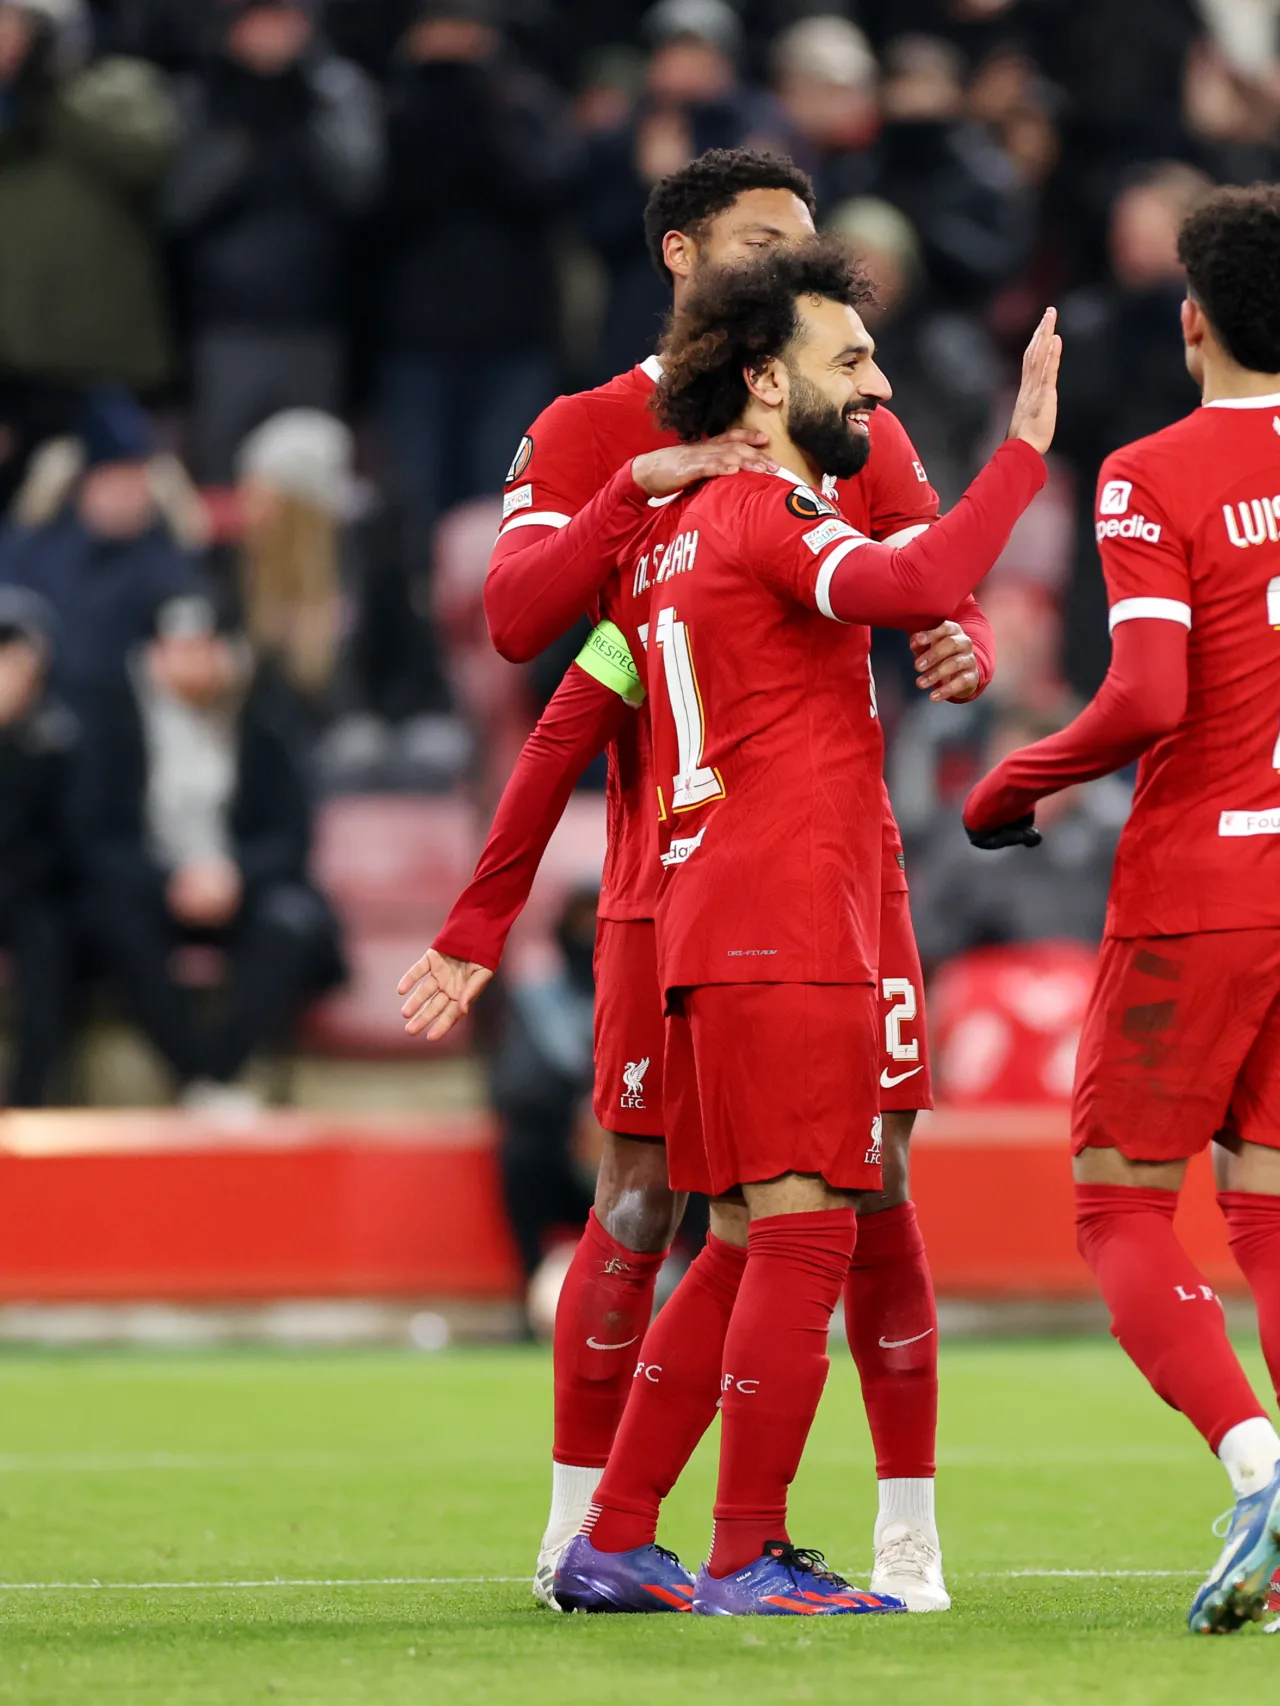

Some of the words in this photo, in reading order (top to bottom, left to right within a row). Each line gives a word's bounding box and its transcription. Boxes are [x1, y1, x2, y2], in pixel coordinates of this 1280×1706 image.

[592, 635, 639, 675] RESPEC
[881, 977, 919, 1061] 2
[633, 1362, 663, 1383] FC
[720, 1373, 760, 1394] FC
